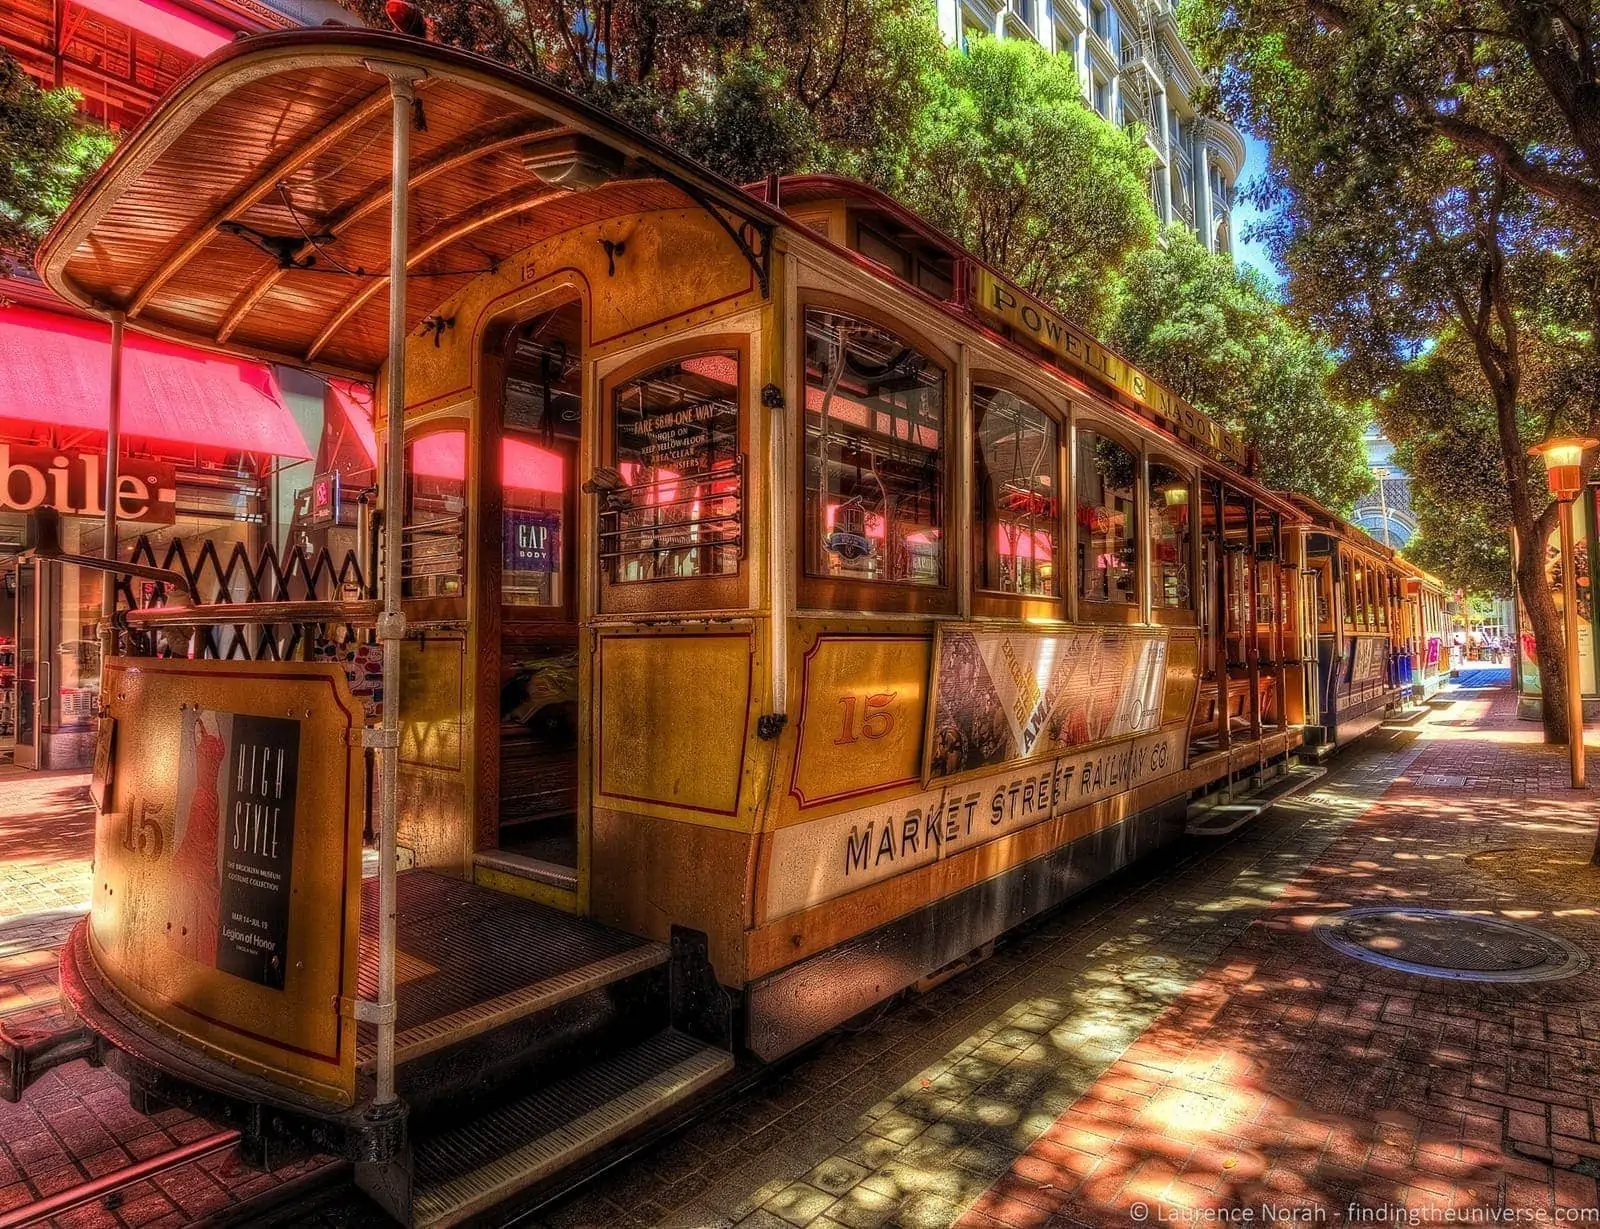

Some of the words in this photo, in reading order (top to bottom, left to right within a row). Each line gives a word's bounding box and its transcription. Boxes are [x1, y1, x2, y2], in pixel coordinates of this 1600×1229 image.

[521, 262, 535, 282] 15
[993, 284, 1117, 381] POWELL
[1133, 376, 1146, 400] &
[1159, 393, 1220, 450] MASON
[634, 419, 653, 435] FARE
[675, 408, 694, 425] ONE
[696, 403, 715, 421] WAY
[656, 430, 676, 442] HOLD
[677, 426, 689, 436] ON
[518, 524, 548, 550] GAP
[519, 551, 548, 559] BODY
[833, 691, 898, 746] 15
[237, 743, 284, 799] HIGH
[845, 801, 978, 875] MARKET
[991, 773, 1073, 825] STREET
[1081, 746, 1148, 795] RAILWAY
[123, 792, 164, 862] 15
[233, 800, 281, 859] STYLE
[249, 878, 280, 892] COLLECTION
[260, 869, 281, 880] MUSEUM
[222, 924, 245, 941] Legion
[245, 933, 253, 944] of
[253, 934, 277, 951] Honor
